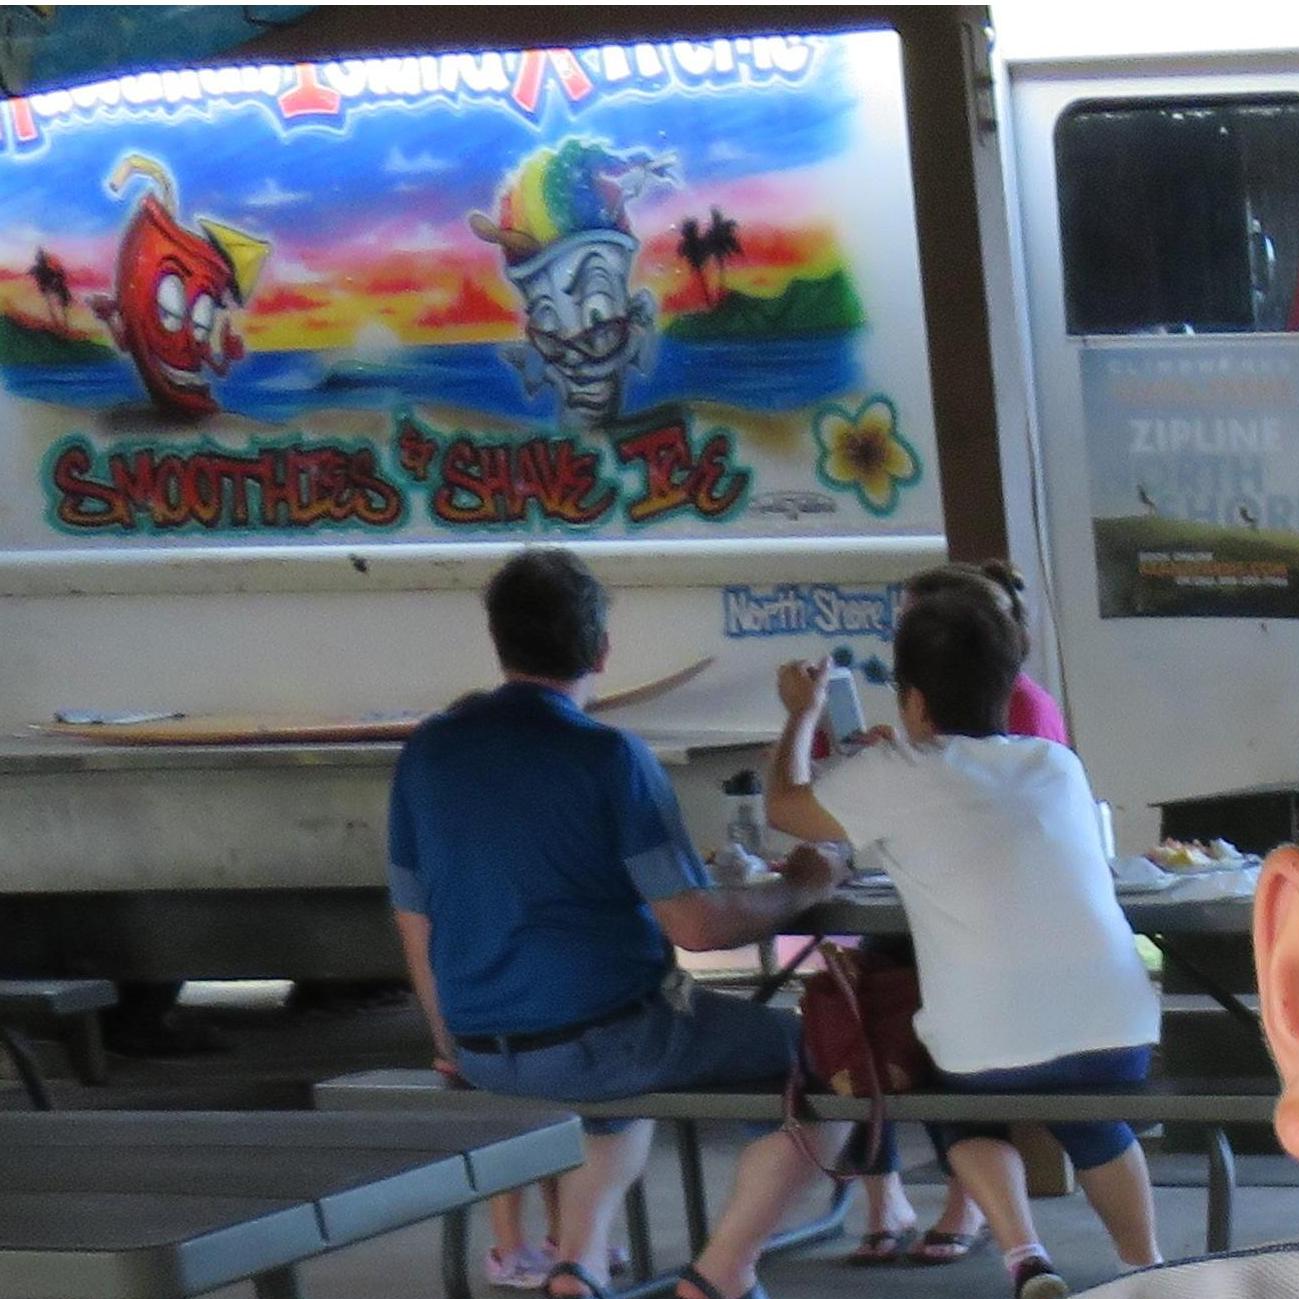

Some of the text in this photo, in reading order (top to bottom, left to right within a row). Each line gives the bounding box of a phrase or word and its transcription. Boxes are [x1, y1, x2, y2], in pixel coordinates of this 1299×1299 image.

[1129, 418, 1282, 453] ZIPLINE
[54, 444, 403, 527] SMOOTHIES
[436, 437, 617, 523] SHAVE
[726, 586, 806, 633] North
